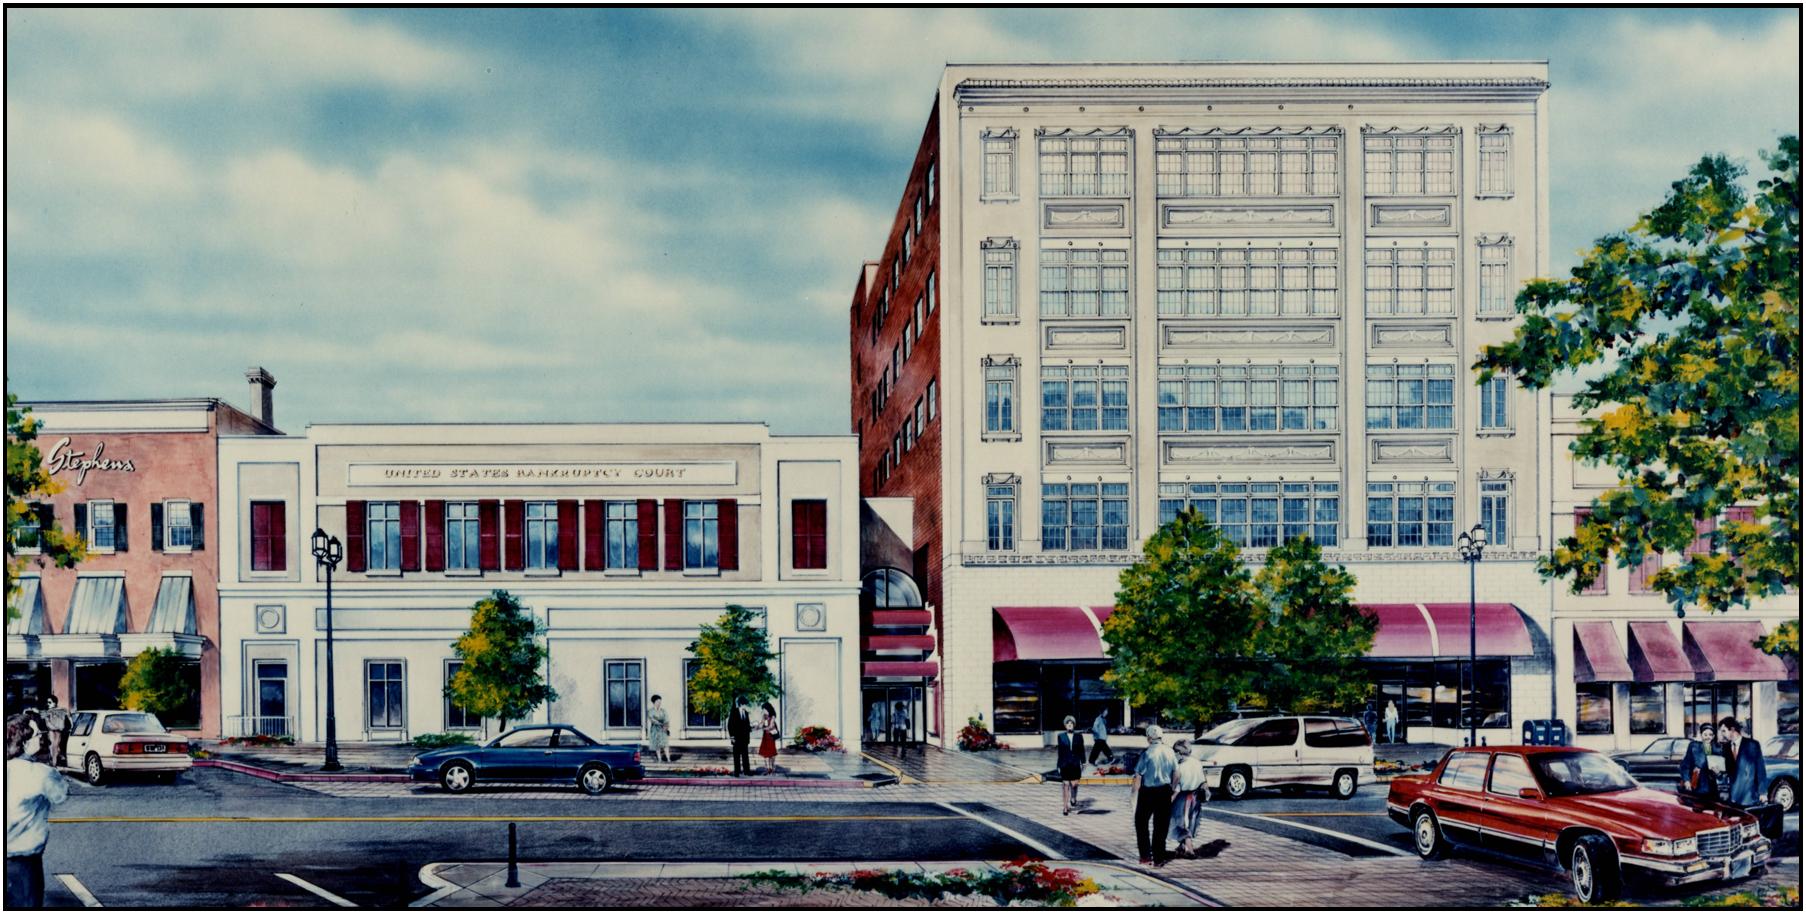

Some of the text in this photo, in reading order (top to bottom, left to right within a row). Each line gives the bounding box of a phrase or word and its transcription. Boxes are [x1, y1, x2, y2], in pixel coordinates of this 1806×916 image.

[47, 436, 135, 486] Stephens
[384, 467, 687, 479] UNITED STATES BANKRUPTCY COURT
